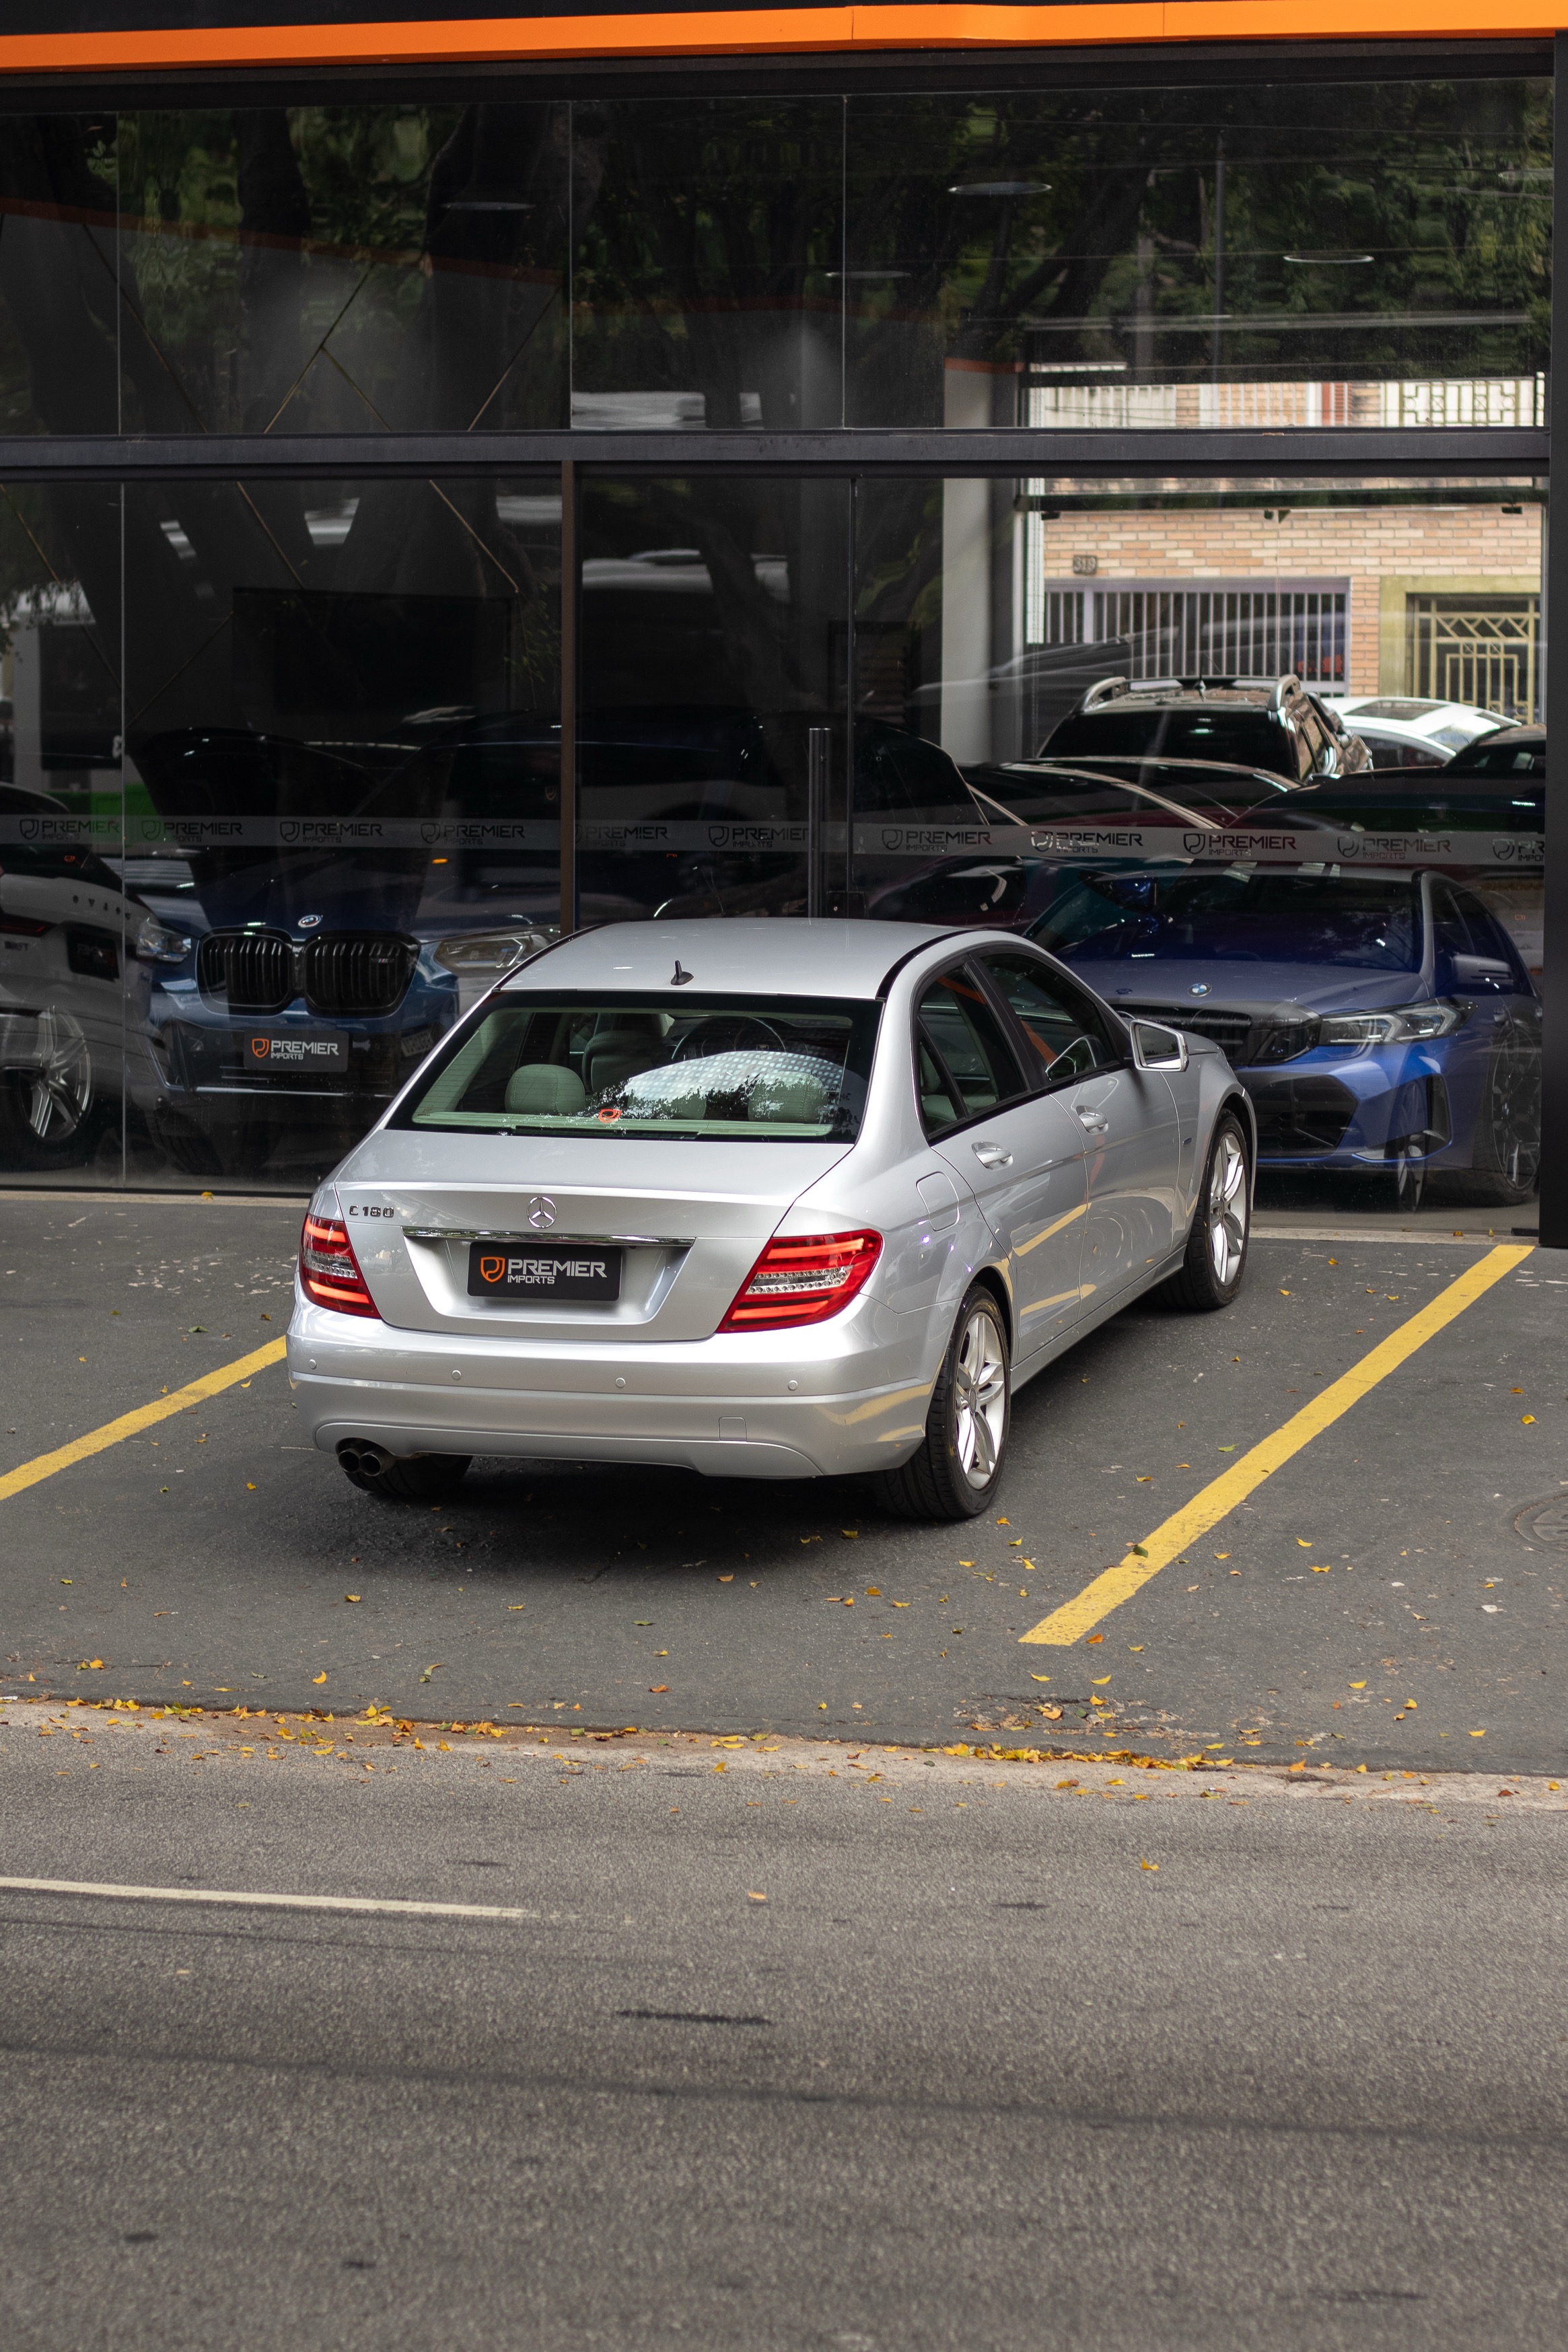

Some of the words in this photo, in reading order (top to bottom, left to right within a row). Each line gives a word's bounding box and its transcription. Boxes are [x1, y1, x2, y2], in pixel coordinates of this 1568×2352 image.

[1075, 557, 1096, 573] 319
[42, 820, 120, 833] PREMIER
[164, 822, 243, 835] PREMIER
[302, 822, 384, 836] PREMIER
[443, 824, 526, 839] PREMIER
[585, 826, 670, 839] PREMIER
[906, 830, 993, 845] PREMIER
[1056, 832, 1143, 847] PREMIER
[1209, 834, 1297, 849] PREMIER
[906, 844, 948, 852] IMPORTS
[1363, 838, 1452, 853] PREMIER
[1363, 852, 1406, 860] IMPORTS
[271, 1040, 340, 1056] PREMIER
[271, 1052, 304, 1060] IMPORTS
[349, 1205, 359, 1216] C
[362, 1205, 394, 1218] 180
[507, 1258, 608, 1278] PREMIER
[507, 1275, 555, 1285] IMPORTS
